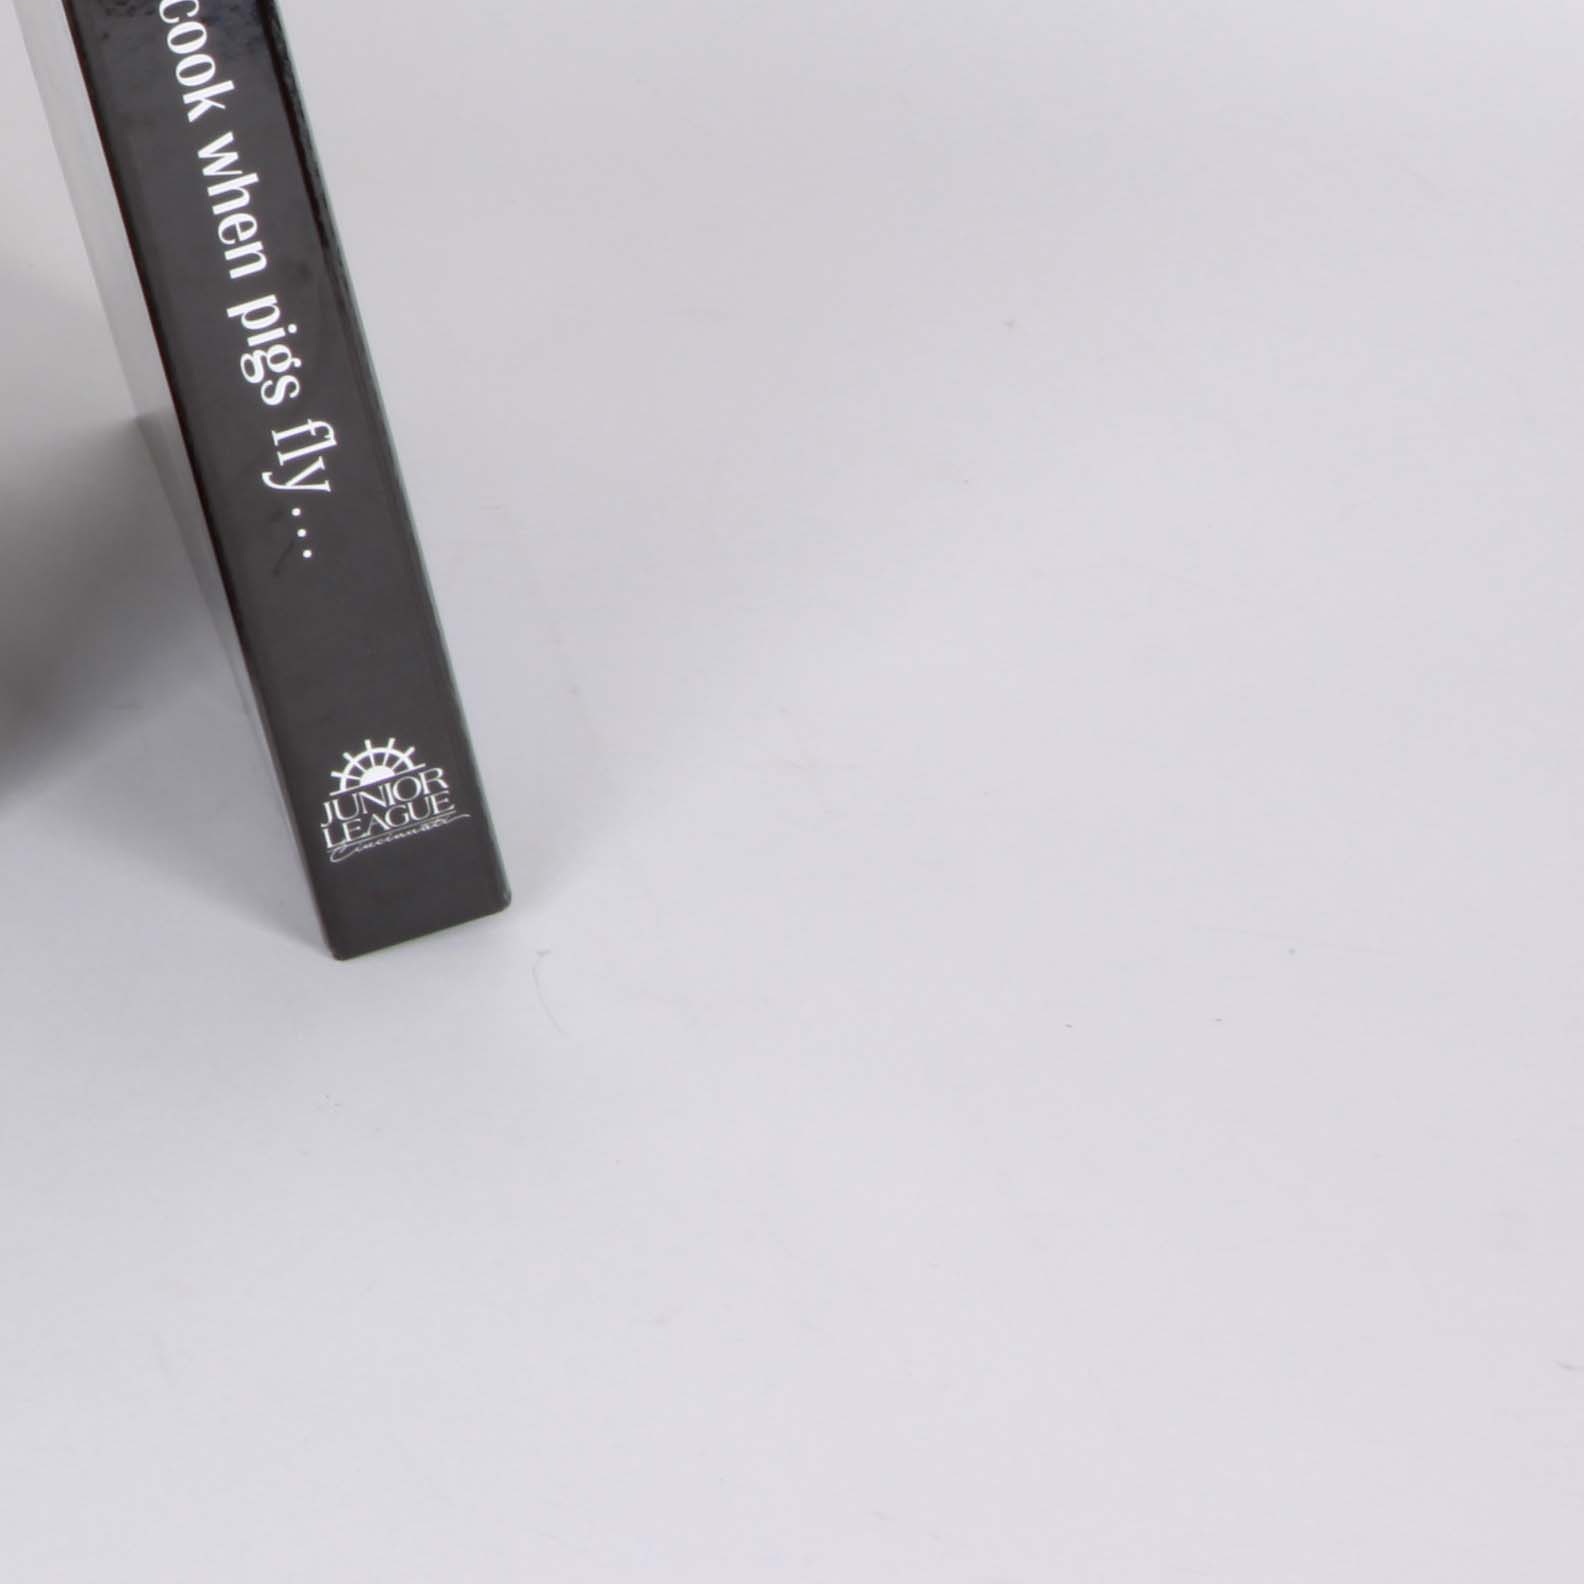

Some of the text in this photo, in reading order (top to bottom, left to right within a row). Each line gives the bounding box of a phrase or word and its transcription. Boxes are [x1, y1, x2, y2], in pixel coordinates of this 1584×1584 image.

[195, 131, 270, 281] when
[226, 294, 301, 408] pigs
[320, 767, 449, 828] JUNIOR
[322, 790, 455, 849] LEAGUE
